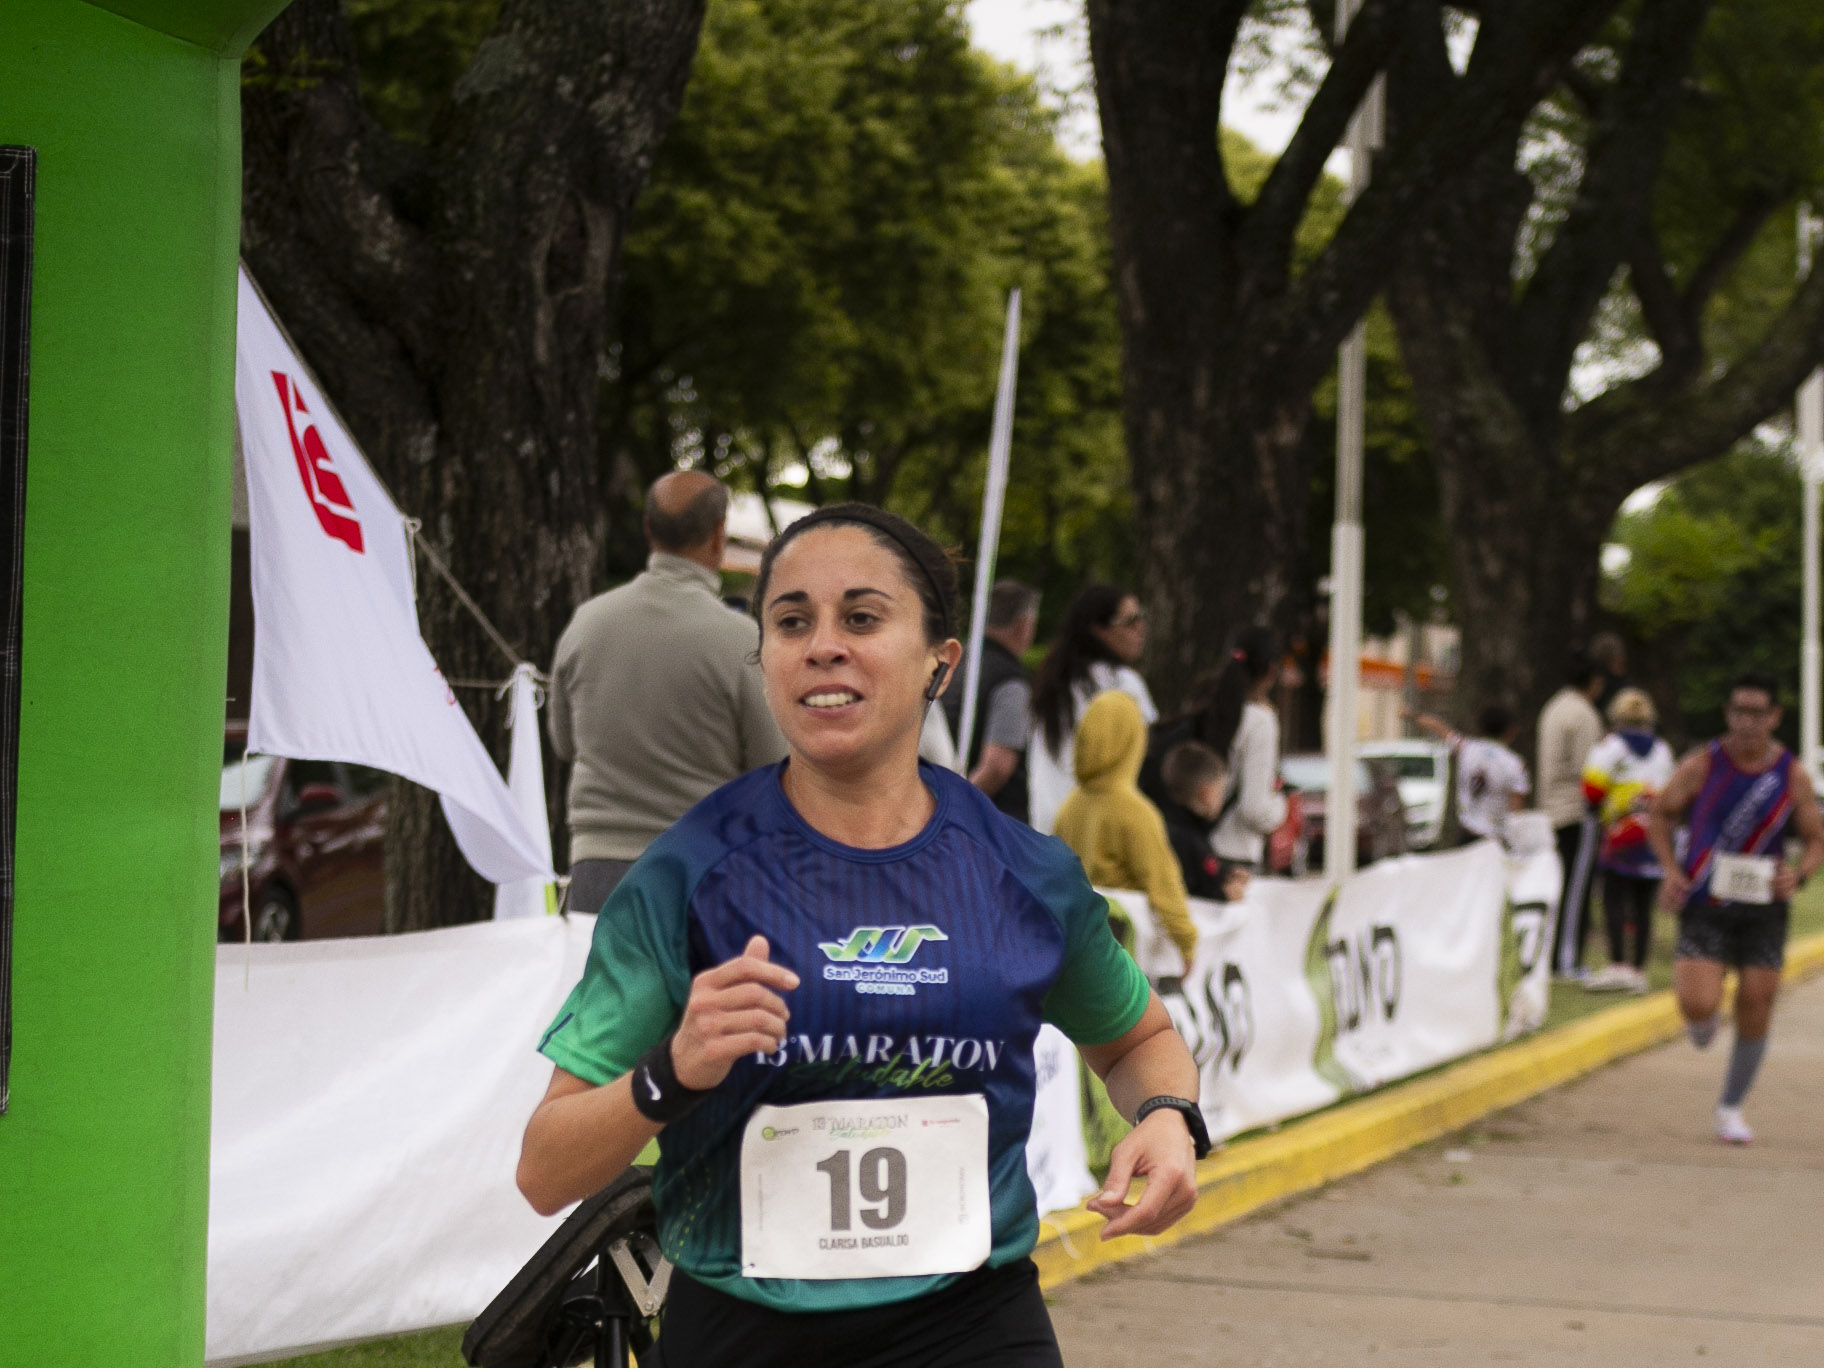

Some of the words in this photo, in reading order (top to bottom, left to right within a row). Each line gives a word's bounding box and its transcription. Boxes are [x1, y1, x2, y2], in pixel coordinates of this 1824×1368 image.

[825, 967, 853, 979] San
[854, 967, 917, 982] Jerónimo
[919, 970, 946, 983] Sud
[857, 983, 914, 994] COMUNA
[797, 1034, 1005, 1072] MARATON
[816, 1147, 907, 1231] 19
[819, 1237, 858, 1250] CLARISA
[861, 1234, 909, 1249] BASUALDO
